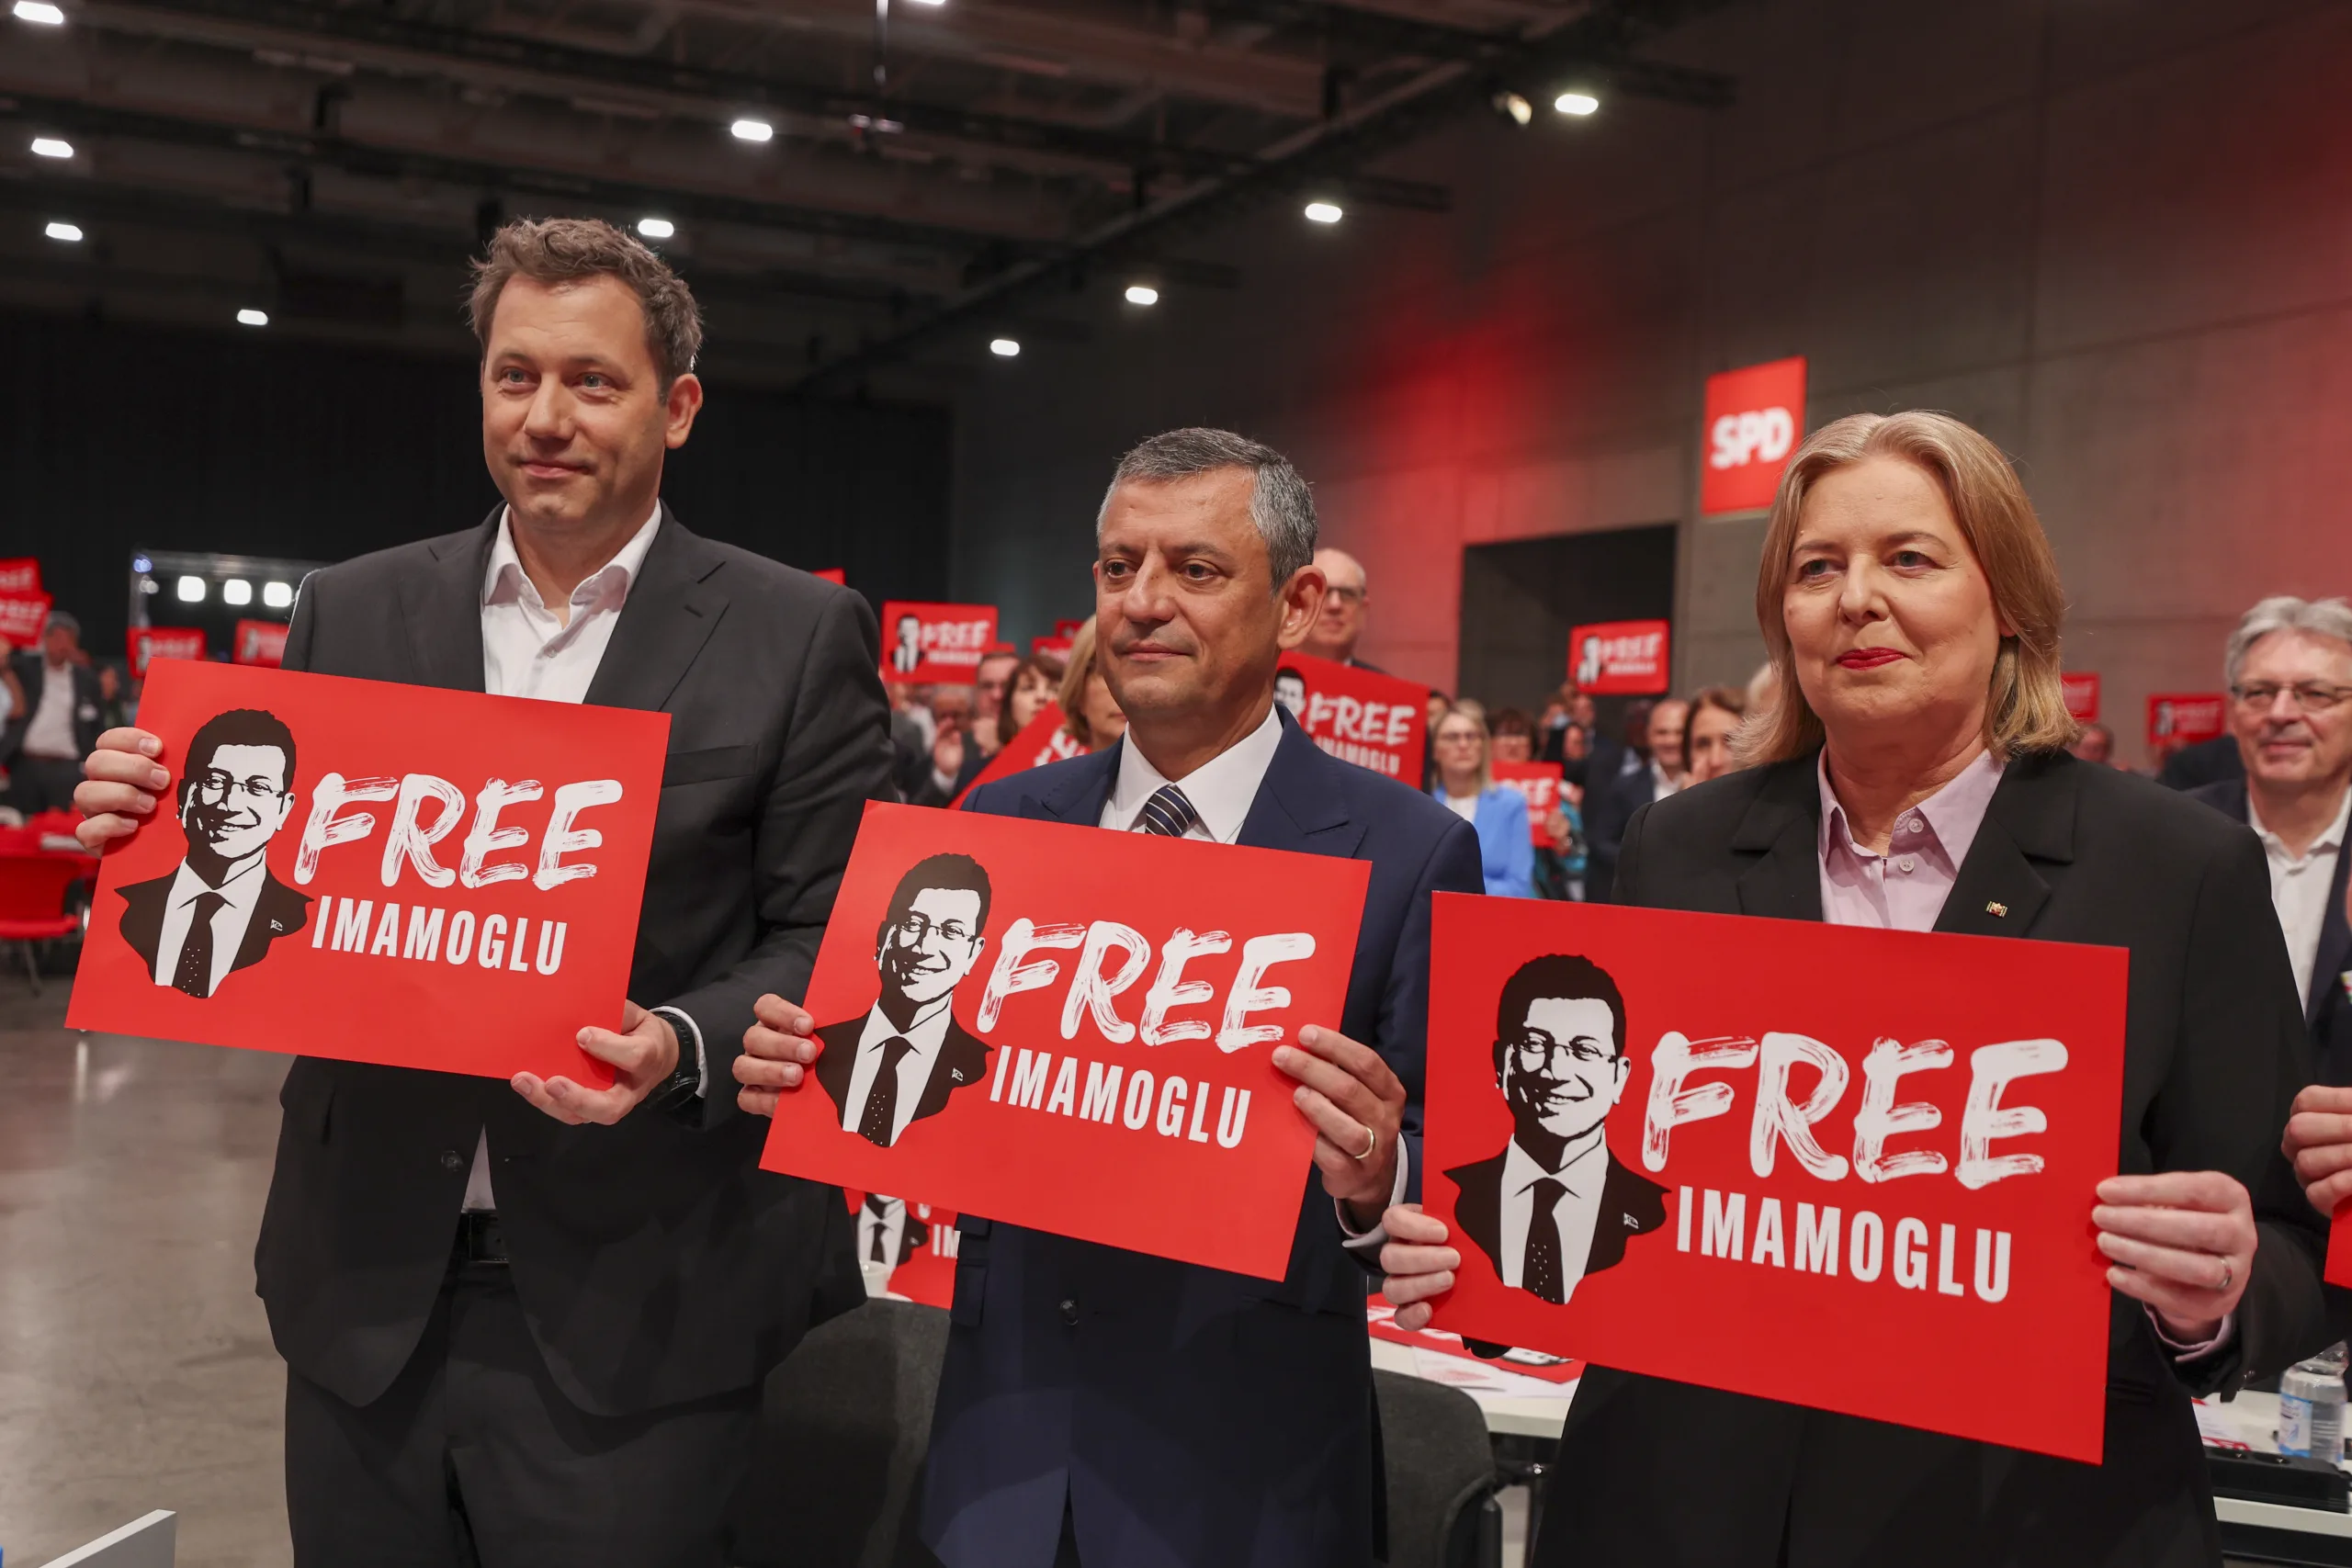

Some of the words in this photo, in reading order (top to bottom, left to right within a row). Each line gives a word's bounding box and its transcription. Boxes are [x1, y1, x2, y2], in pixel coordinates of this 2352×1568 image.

[1711, 406, 1794, 470] SPD
[1306, 692, 1416, 745] FREE
[293, 772, 624, 891] FREE
[311, 895, 568, 976] IMAMOGLU
[976, 917, 1317, 1054] FREE
[989, 1044, 1251, 1149] IMAMOGLU
[1641, 1031, 2069, 1190] FREE
[1676, 1185, 2012, 1303] IMAMOGLU
